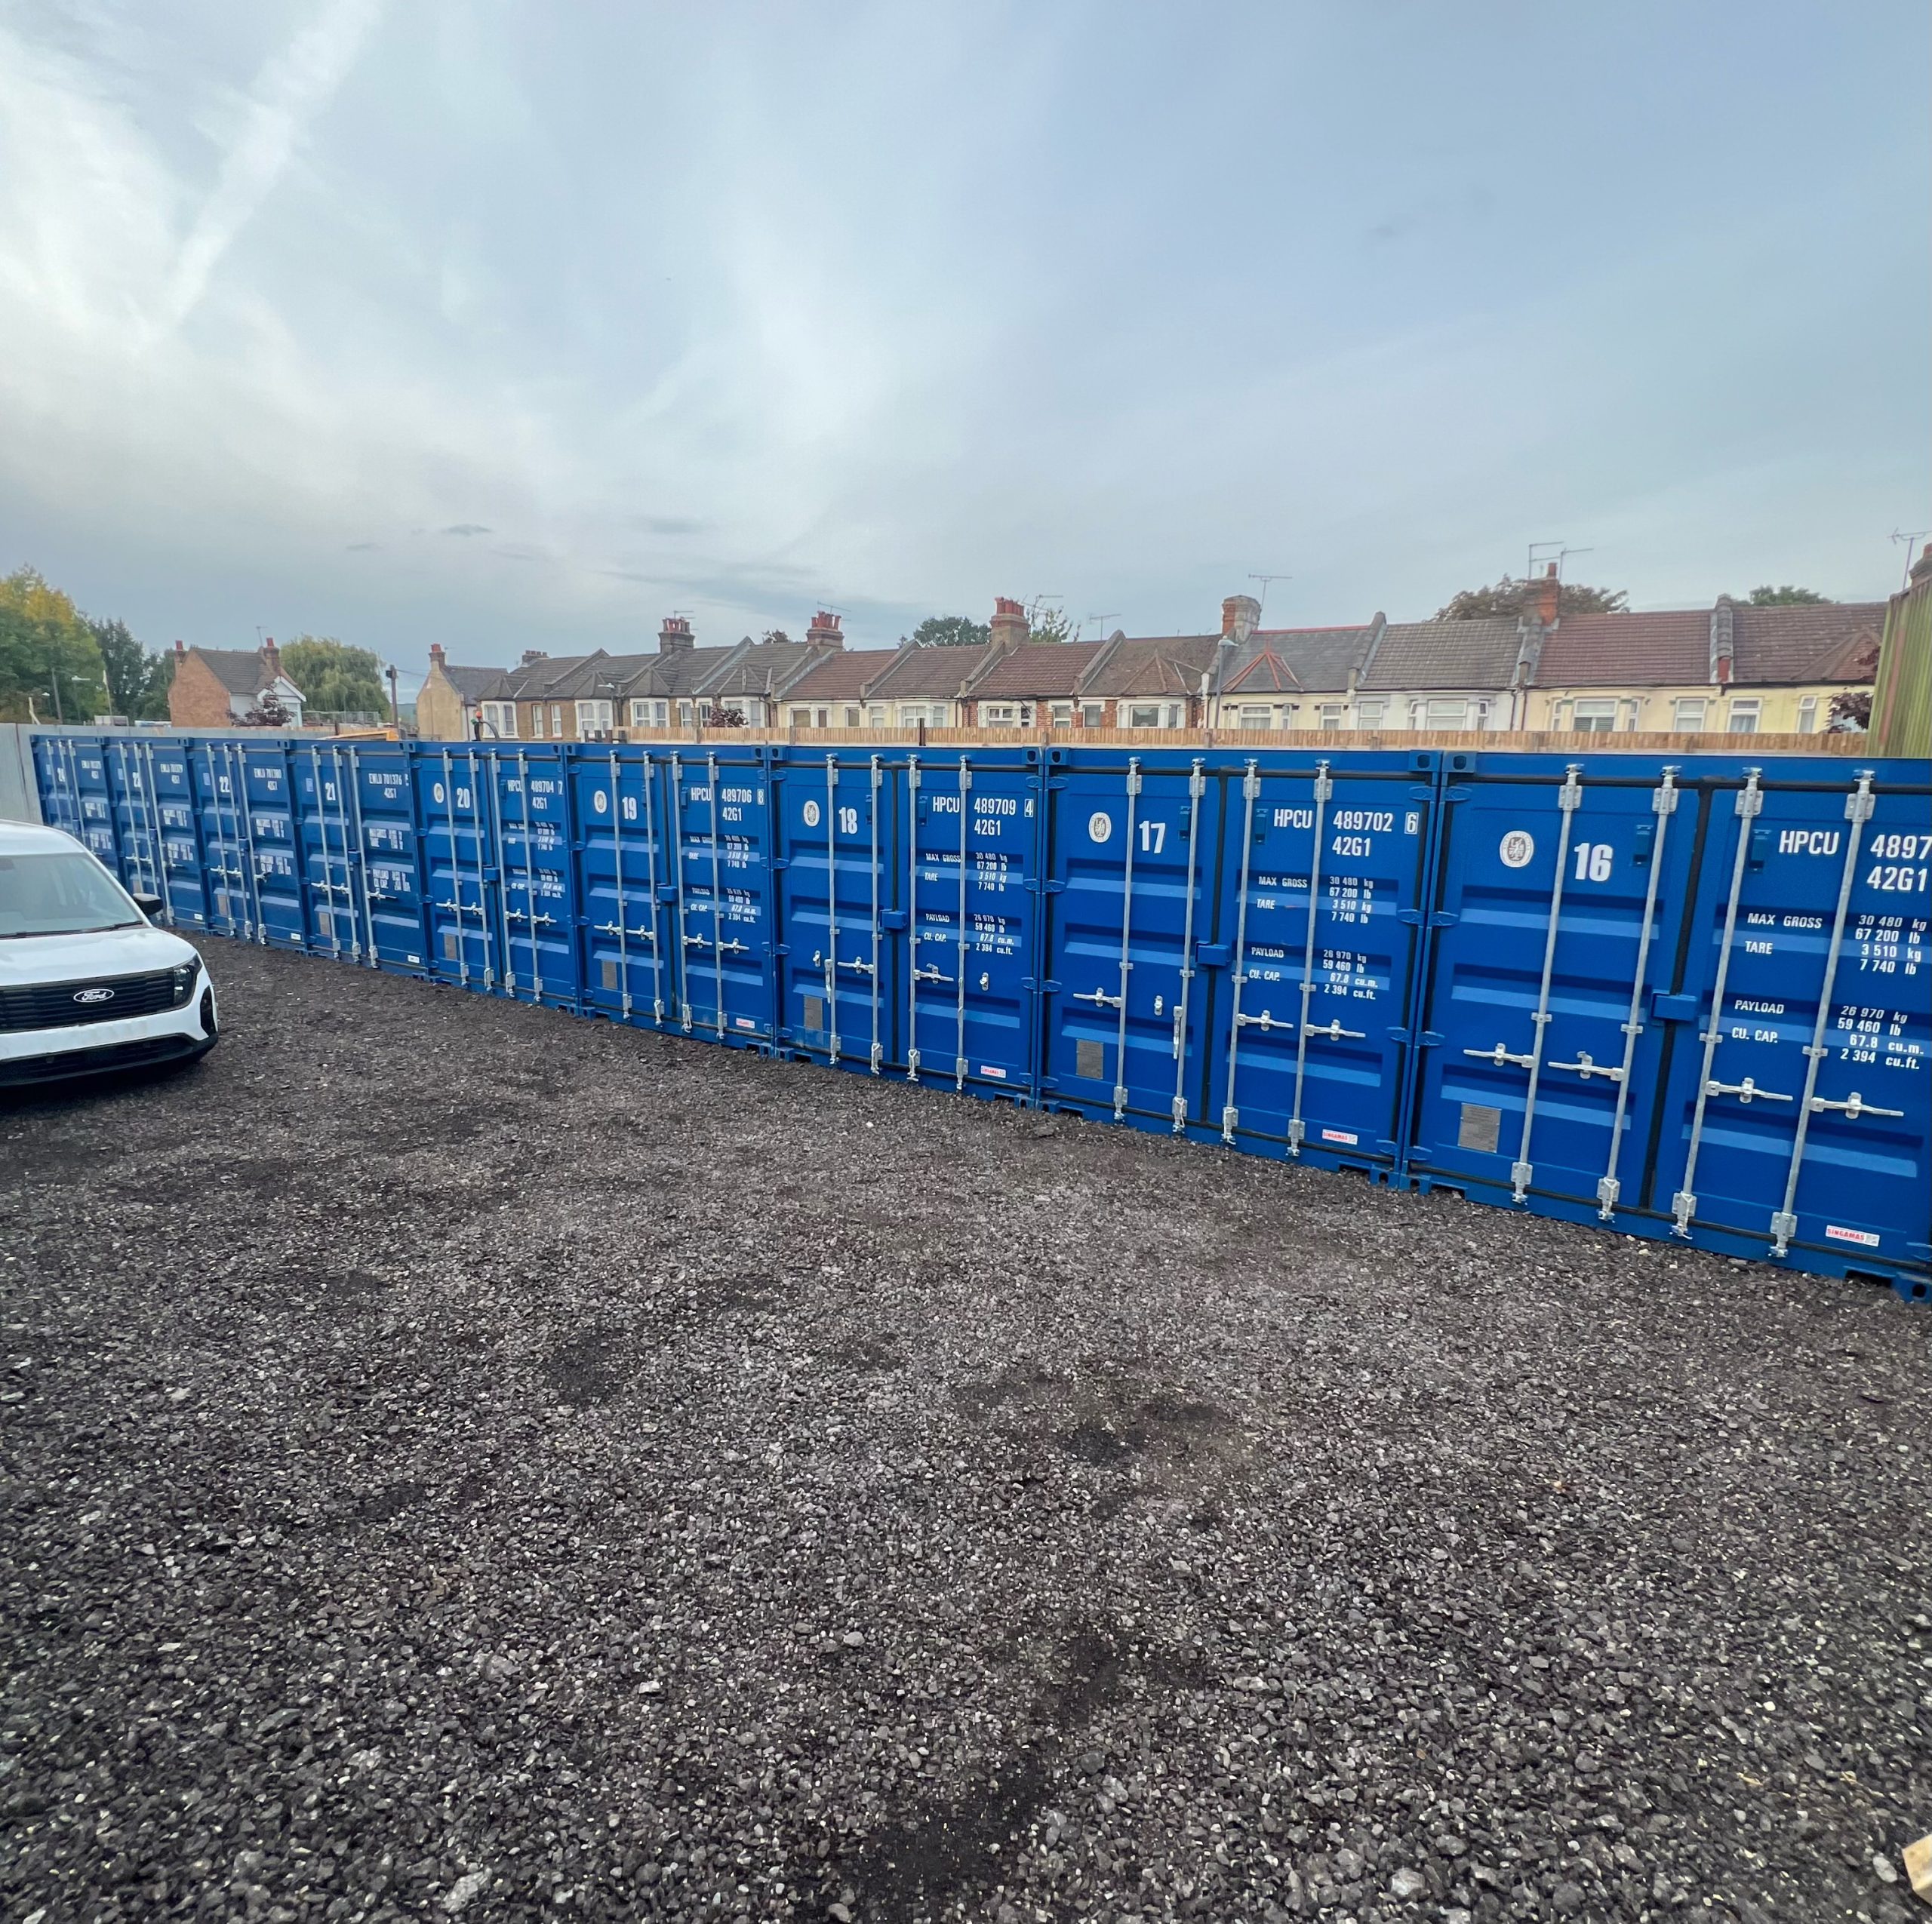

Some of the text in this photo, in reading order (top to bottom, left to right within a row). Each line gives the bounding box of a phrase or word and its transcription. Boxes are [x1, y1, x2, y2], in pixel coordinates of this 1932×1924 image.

[457, 788, 470, 809] 20
[533, 797, 547, 810] 42G1
[691, 788, 764, 805] HPCU 489706 8
[623, 797, 637, 820] 19
[723, 807, 743, 822] 42G1
[933, 797, 1033, 817] HPCU 489709 4
[839, 807, 858, 834] 18
[974, 819, 1001, 836] 42G1
[1274, 809, 1418, 834] HPCU 489702 6
[1139, 820, 1166, 854] 17
[1779, 831, 1932, 859] HPCU 4897
[1332, 836, 1371, 857] 42G1
[1574, 843, 1614, 881] 16
[1259, 877, 1277, 886] MAX
[1282, 878, 1308, 888] GROSS
[1364, 879, 1374, 889] kg
[1867, 866, 1927, 892] 42G1
[1330, 887, 1371, 899] 67 200 lb
[1257, 899, 1275, 909] TARE
[1340, 901, 1356, 911] 510
[1362, 902, 1371, 913] kg
[1340, 912, 1355, 923] 740
[1361, 914, 1368, 924] lb
[1748, 913, 1927, 931] MAX GROSS 30 480 kg
[1855, 928, 1921, 944] 67 200 lb
[1251, 947, 1284, 958] PAYLOAD
[1358, 954, 1367, 964] kg
[1746, 941, 1921, 962] TARE 3 510 kg
[1323, 960, 1364, 973] 59 460 lb
[1860, 959, 1916, 976] 7 740 lb
[1249, 970, 1261, 979] CU.
[1264, 971, 1281, 982] CAP.
[1330, 973, 1349, 983] 67.8
[80, 991, 108, 1001] Ford
[1332, 986, 1347, 996] 394
[1353, 989, 1376, 1000] cu.ft.
[1735, 1000, 1908, 1024] PAYLOAD 26 970 kg
[1838, 1017, 1901, 1037] 59 460 lb
[1732, 1027, 1924, 1055] CU. CAP. 67.8 cu.m.
[1840, 1048, 1920, 1070] 2 394 cu.ft.
[1828, 1229, 1865, 1240] SINGAMAS
